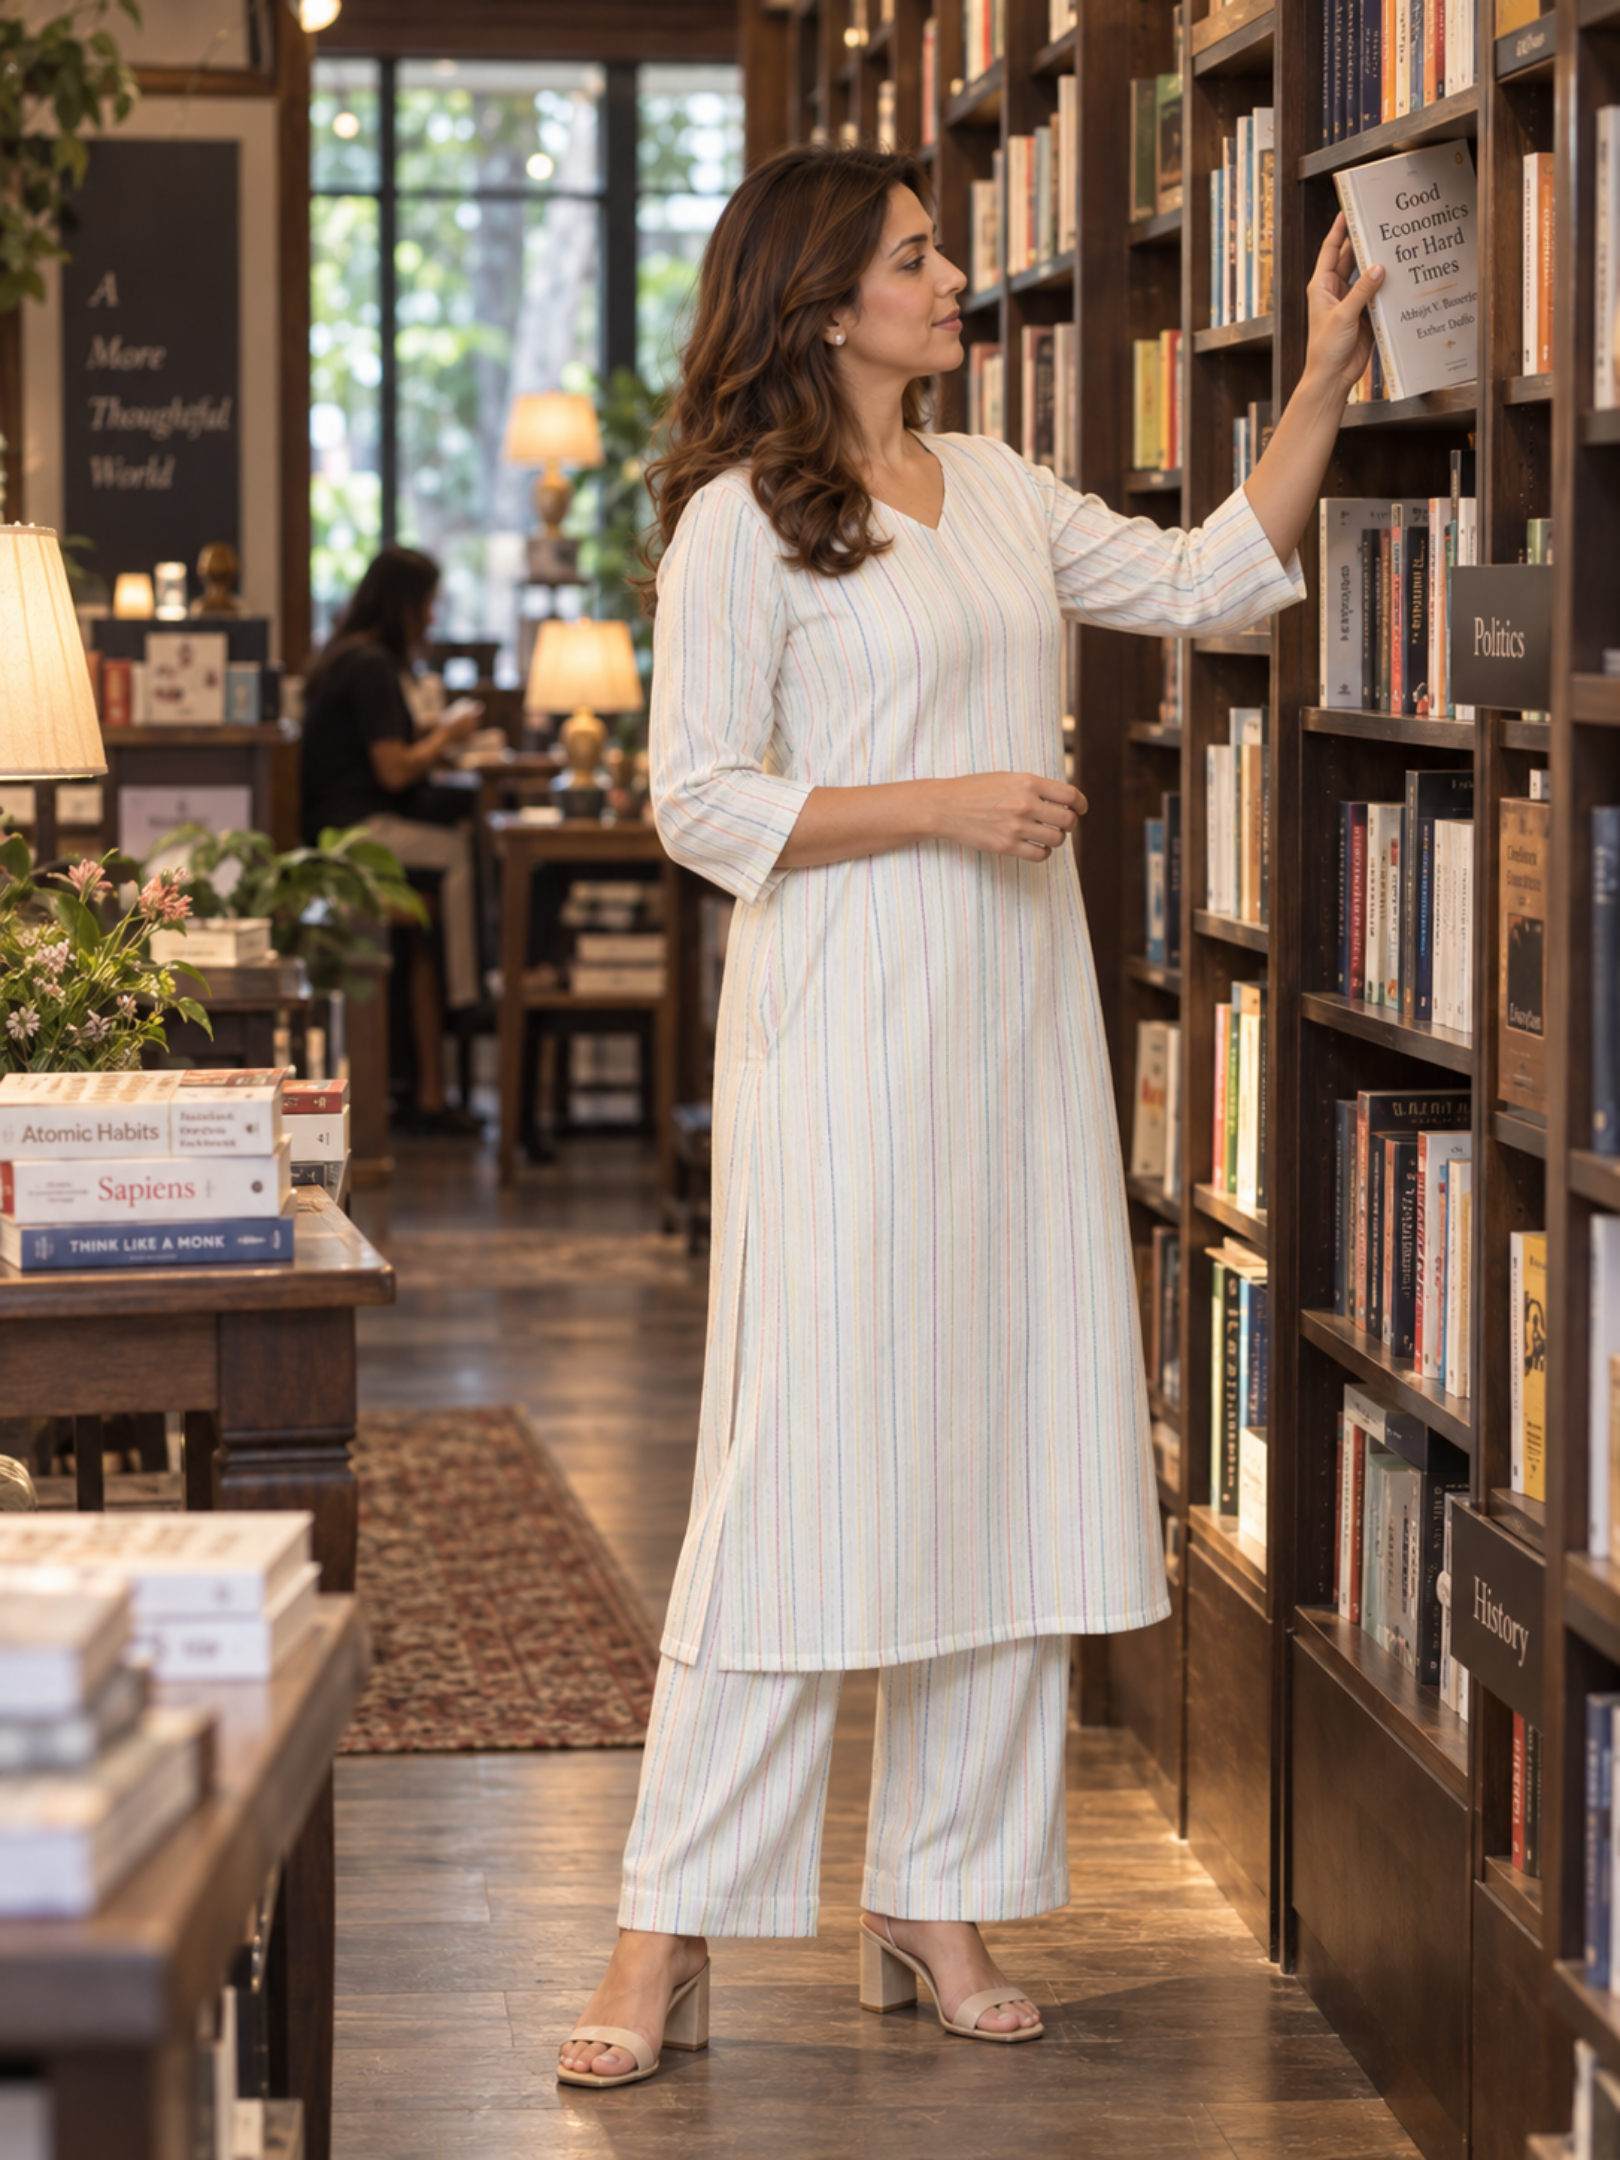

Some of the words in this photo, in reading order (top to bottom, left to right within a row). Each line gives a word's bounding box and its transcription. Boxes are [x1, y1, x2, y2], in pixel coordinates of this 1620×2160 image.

[1395, 182, 1441, 211] Good
[1379, 204, 1469, 241] Economics
[1395, 244, 1419, 263] for
[1422, 226, 1465, 255] Hard
[87, 270, 119, 308] A
[1408, 260, 1460, 284] Times
[86, 334, 166, 370] More
[87, 395, 232, 440] Thoughtful
[90, 454, 176, 489] World
[1473, 616, 1526, 659] Politics
[22, 1124, 93, 1144] Atomic
[98, 1122, 160, 1142] Habits
[98, 1176, 196, 1208] Sapiens
[69, 1239, 119, 1253] THINK
[123, 1238, 157, 1251] LIKE
[162, 1237, 174, 1250] A
[177, 1235, 225, 1249] MONK
[1473, 1575, 1529, 1668] History
